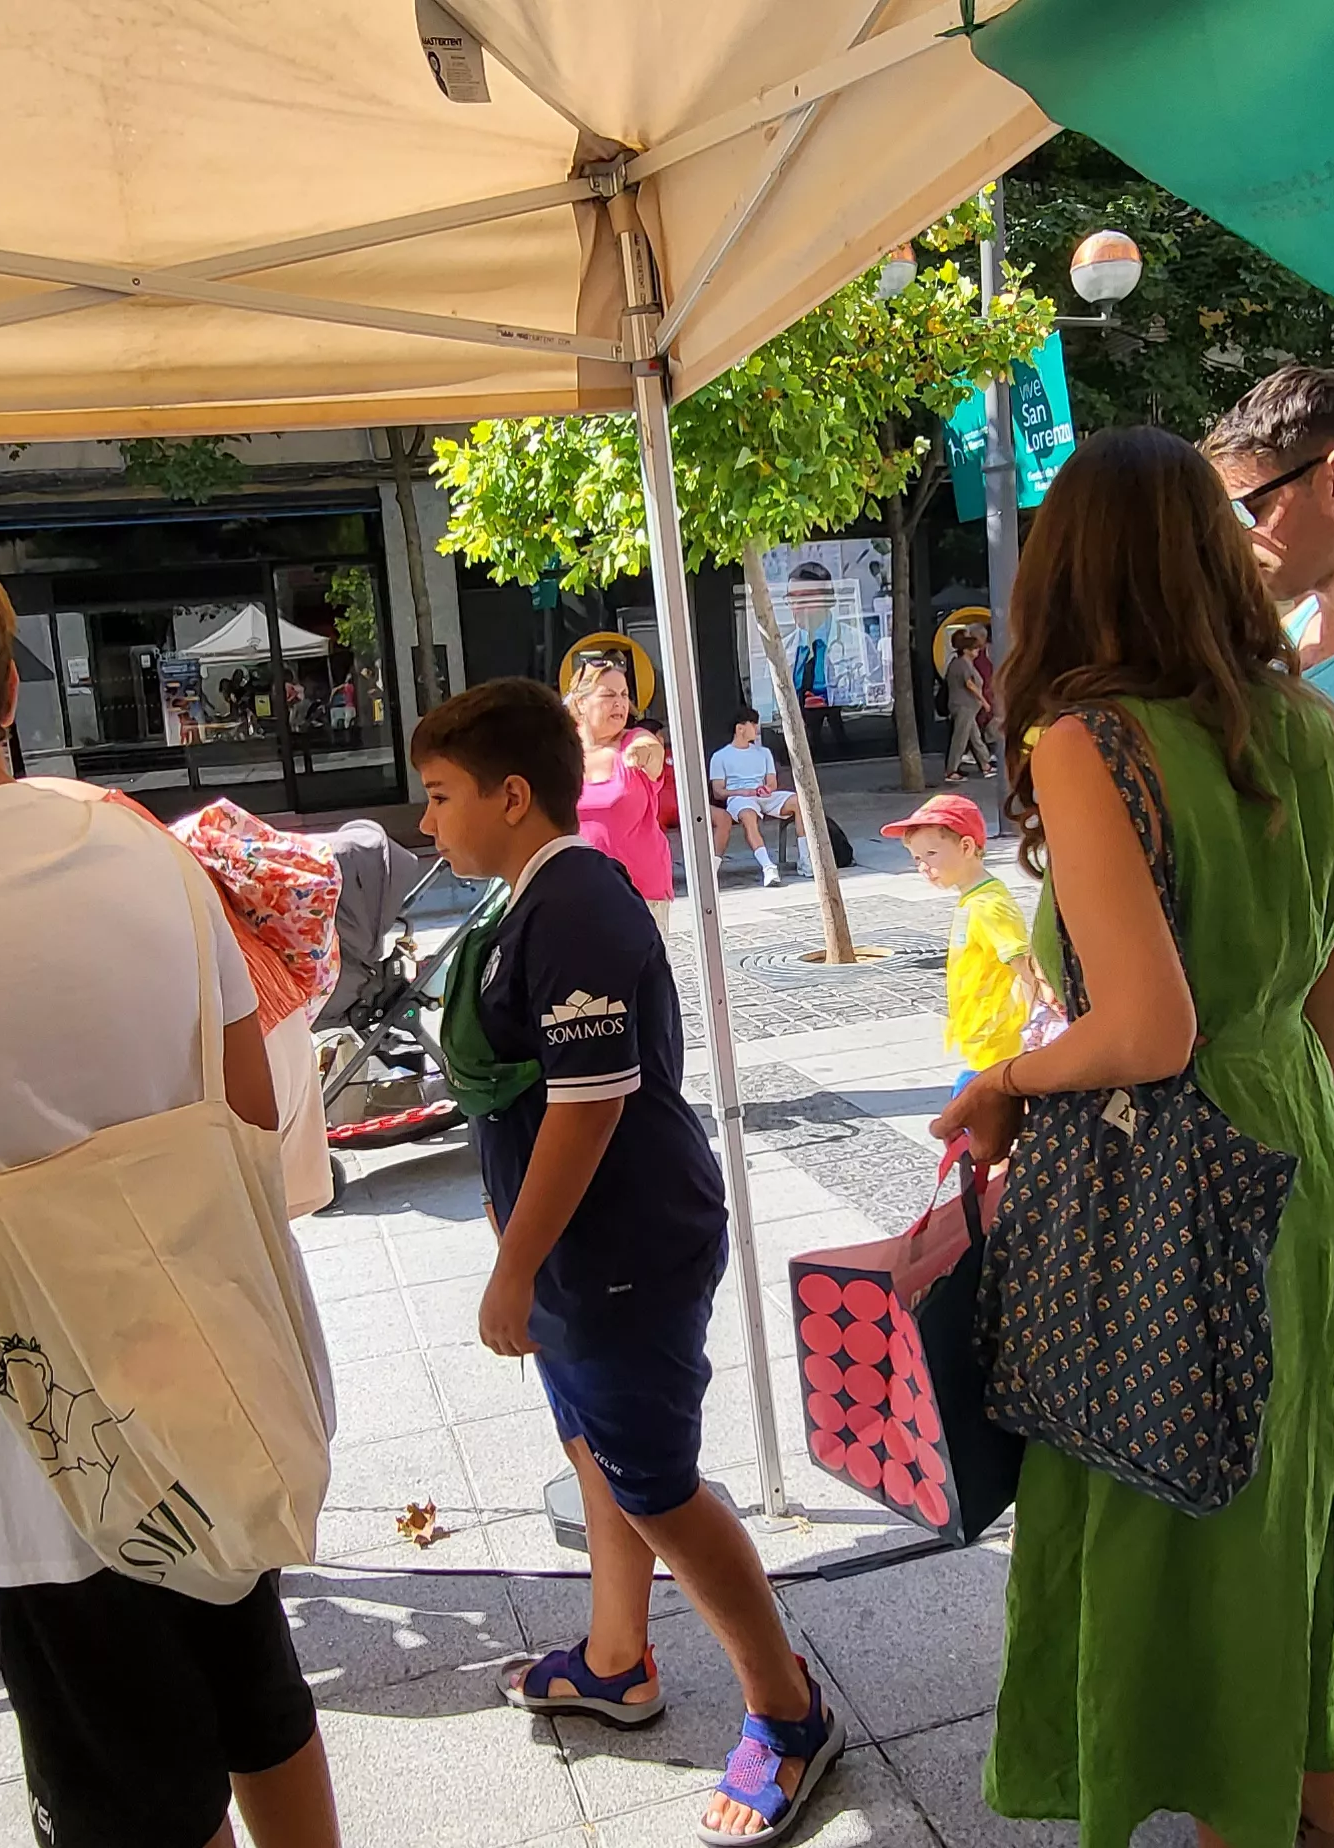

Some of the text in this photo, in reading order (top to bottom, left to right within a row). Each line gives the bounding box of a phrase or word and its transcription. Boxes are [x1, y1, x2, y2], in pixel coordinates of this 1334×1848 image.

[1019, 376, 1042, 401] vive
[1022, 403, 1047, 427] San
[1025, 423, 1073, 453] Lorenzo
[546, 1017, 625, 1046] SOMMOS
